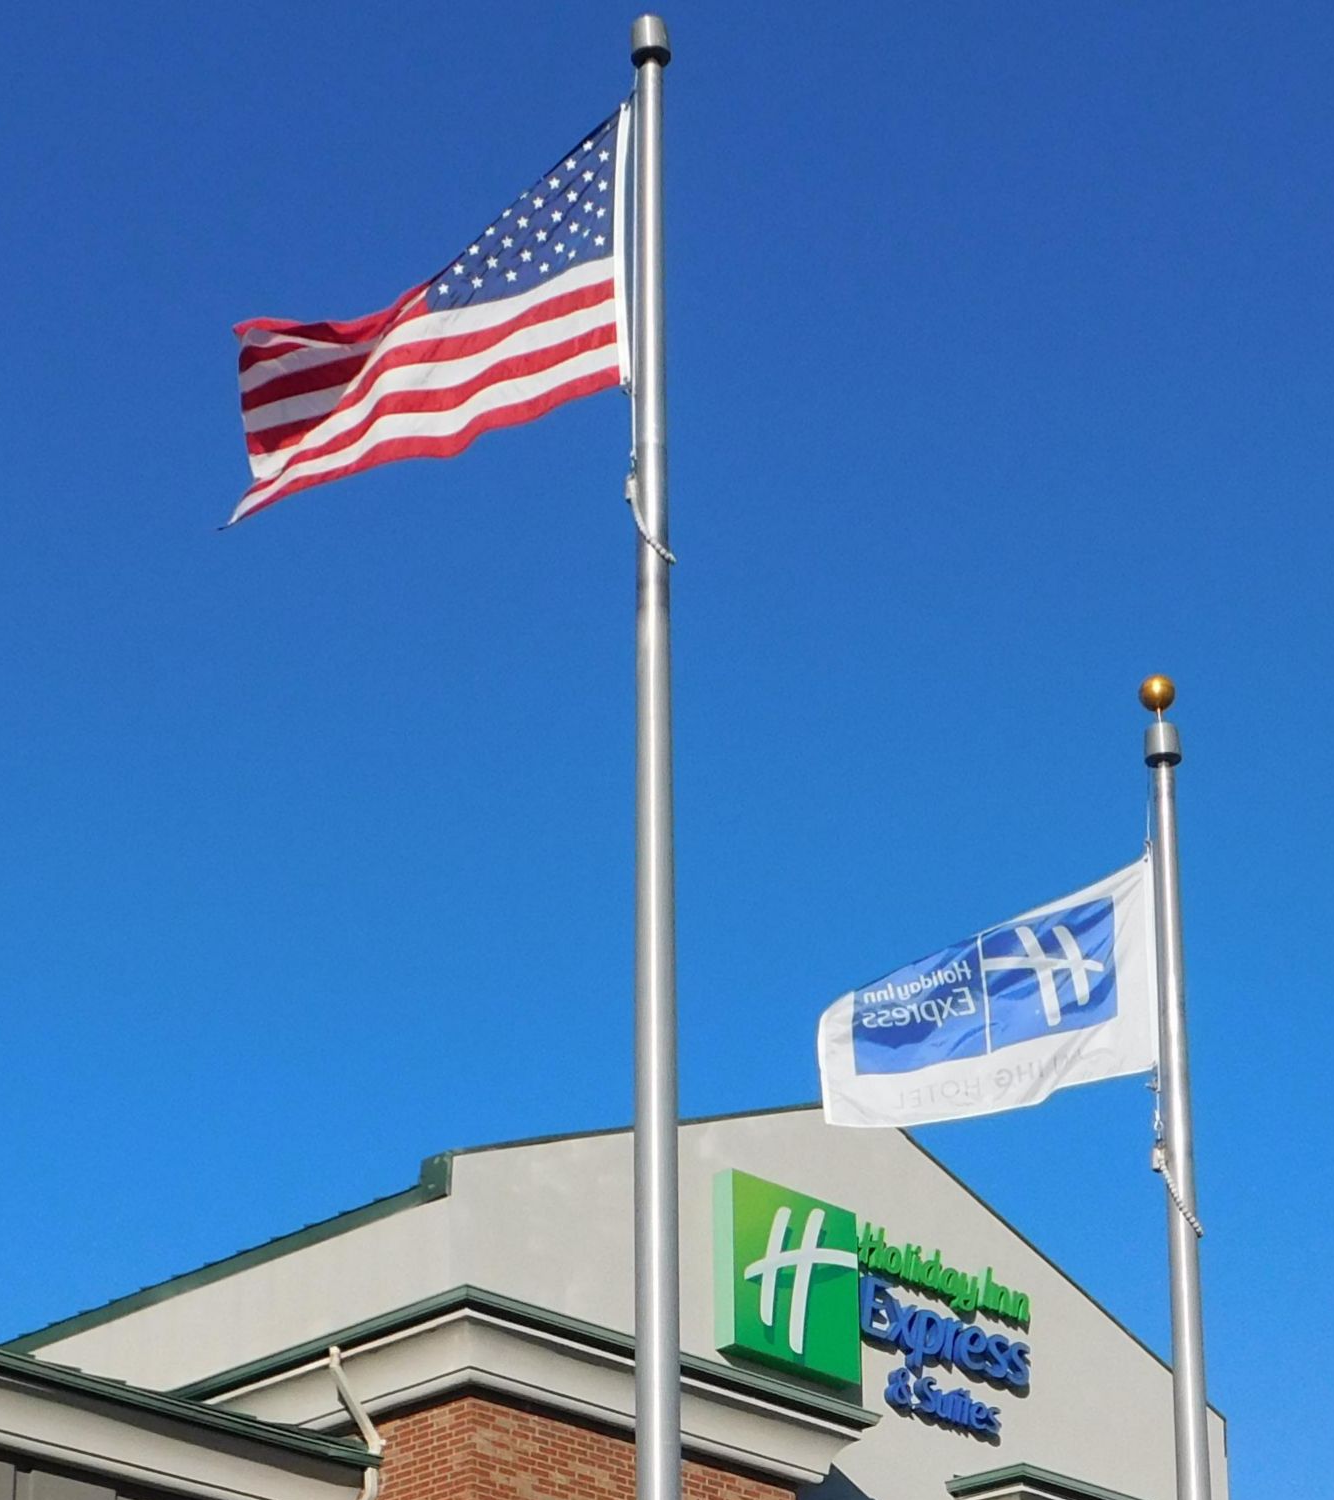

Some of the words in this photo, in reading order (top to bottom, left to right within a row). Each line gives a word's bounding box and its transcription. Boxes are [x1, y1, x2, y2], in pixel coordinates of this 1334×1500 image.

[858, 1222, 978, 1313] Holiday
[977, 1267, 1030, 1324] Inn
[860, 1275, 1030, 1387] Express
[884, 1367, 912, 1408] &
[913, 1376, 1001, 1434] Suites
